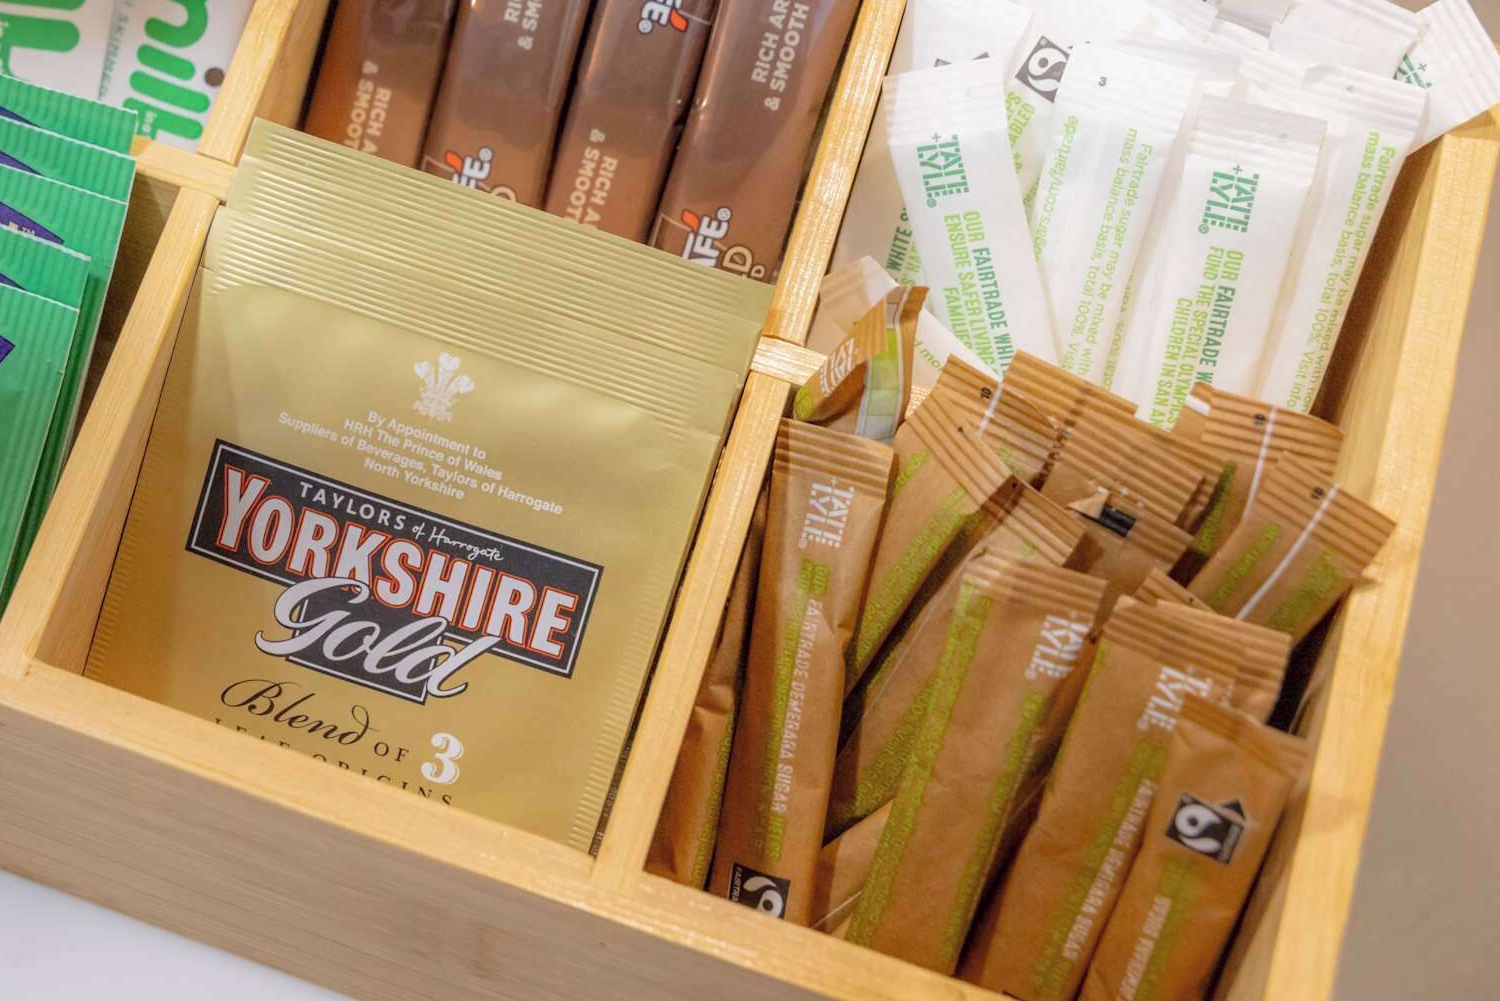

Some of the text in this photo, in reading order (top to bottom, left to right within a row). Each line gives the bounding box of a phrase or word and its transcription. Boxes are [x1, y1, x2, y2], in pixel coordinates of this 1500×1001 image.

[362, 59, 380, 75] &
[517, 34, 534, 51] &
[750, 31, 780, 83] RICH
[769, 2, 811, 93] SMOOTH
[344, 77, 376, 151] SMOOT
[365, 85, 393, 137] RICH
[764, 95, 782, 112] &
[1008, 103, 1035, 149] ABLED
[588, 127, 607, 143] &
[1119, 127, 1138, 164] mass
[1361, 130, 1381, 170] mass
[564, 146, 600, 224] SMOOT
[590, 154, 620, 206] RICH
[915, 142, 947, 199] LYLE
[937, 133, 970, 197] TATE
[1034, 114, 1079, 264] ugars.com/fairtrade
[1124, 142, 1153, 207] Fairtrade
[1365, 146, 1396, 211] Fairtrade
[1102, 167, 1125, 223] balance
[1202, 170, 1236, 226] LYLE
[1226, 172, 1260, 234] TATE
[1344, 171, 1370, 230] balance
[885, 226, 913, 272] WHITE
[1113, 209, 1134, 249] sugar
[1354, 213, 1373, 253] sugar
[1082, 264, 1101, 298] total
[1102, 250, 1120, 281] may
[1203, 245, 1226, 281] FUND
[1220, 249, 1245, 282] OUR
[1320, 269, 1340, 306] total
[1341, 255, 1359, 287] may
[943, 213, 997, 367] ENSURE SAFER LIVING
[962, 210, 1015, 378] OUR FAIRTRADE WHI
[1097, 282, 1113, 300] be
[1196, 282, 1217, 307] THE
[1336, 288, 1349, 307] be
[1085, 302, 1105, 346] mixed
[1163, 296, 1194, 368] CHILDREN
[1185, 308, 1210, 361] SPECIAL
[1199, 284, 1237, 368] FAIRTRADE
[1320, 308, 1341, 352] mixed
[1060, 337, 1080, 372] Visit
[1077, 347, 1094, 376] with
[1159, 367, 1176, 380] IN
[1295, 349, 1315, 384] Visit
[1311, 353, 1330, 382] with
[1154, 380, 1173, 407] SAN
[1285, 383, 1307, 410] info
[342, 417, 504, 482] HRH The Prince of Wales
[366, 409, 488, 461] By Appointment to
[277, 410, 565, 517] Suppliers of Beverages, Taylors of Harrogate
[362, 456, 467, 501] North Yorkshire
[299, 481, 505, 562] TAYLORS of Harrogate
[215, 463, 581, 661] YORKSHIRE
[253, 575, 503, 698] Gold
[792, 598, 823, 680] FAIRTRADE
[219, 678, 381, 746] Blend
[373, 740, 411, 764] OF
[420, 731, 465, 785] 3
[779, 680, 806, 761] DEMERARA
[770, 762, 795, 816] SUGAR
[729, 866, 744, 902] FAIRTRA
